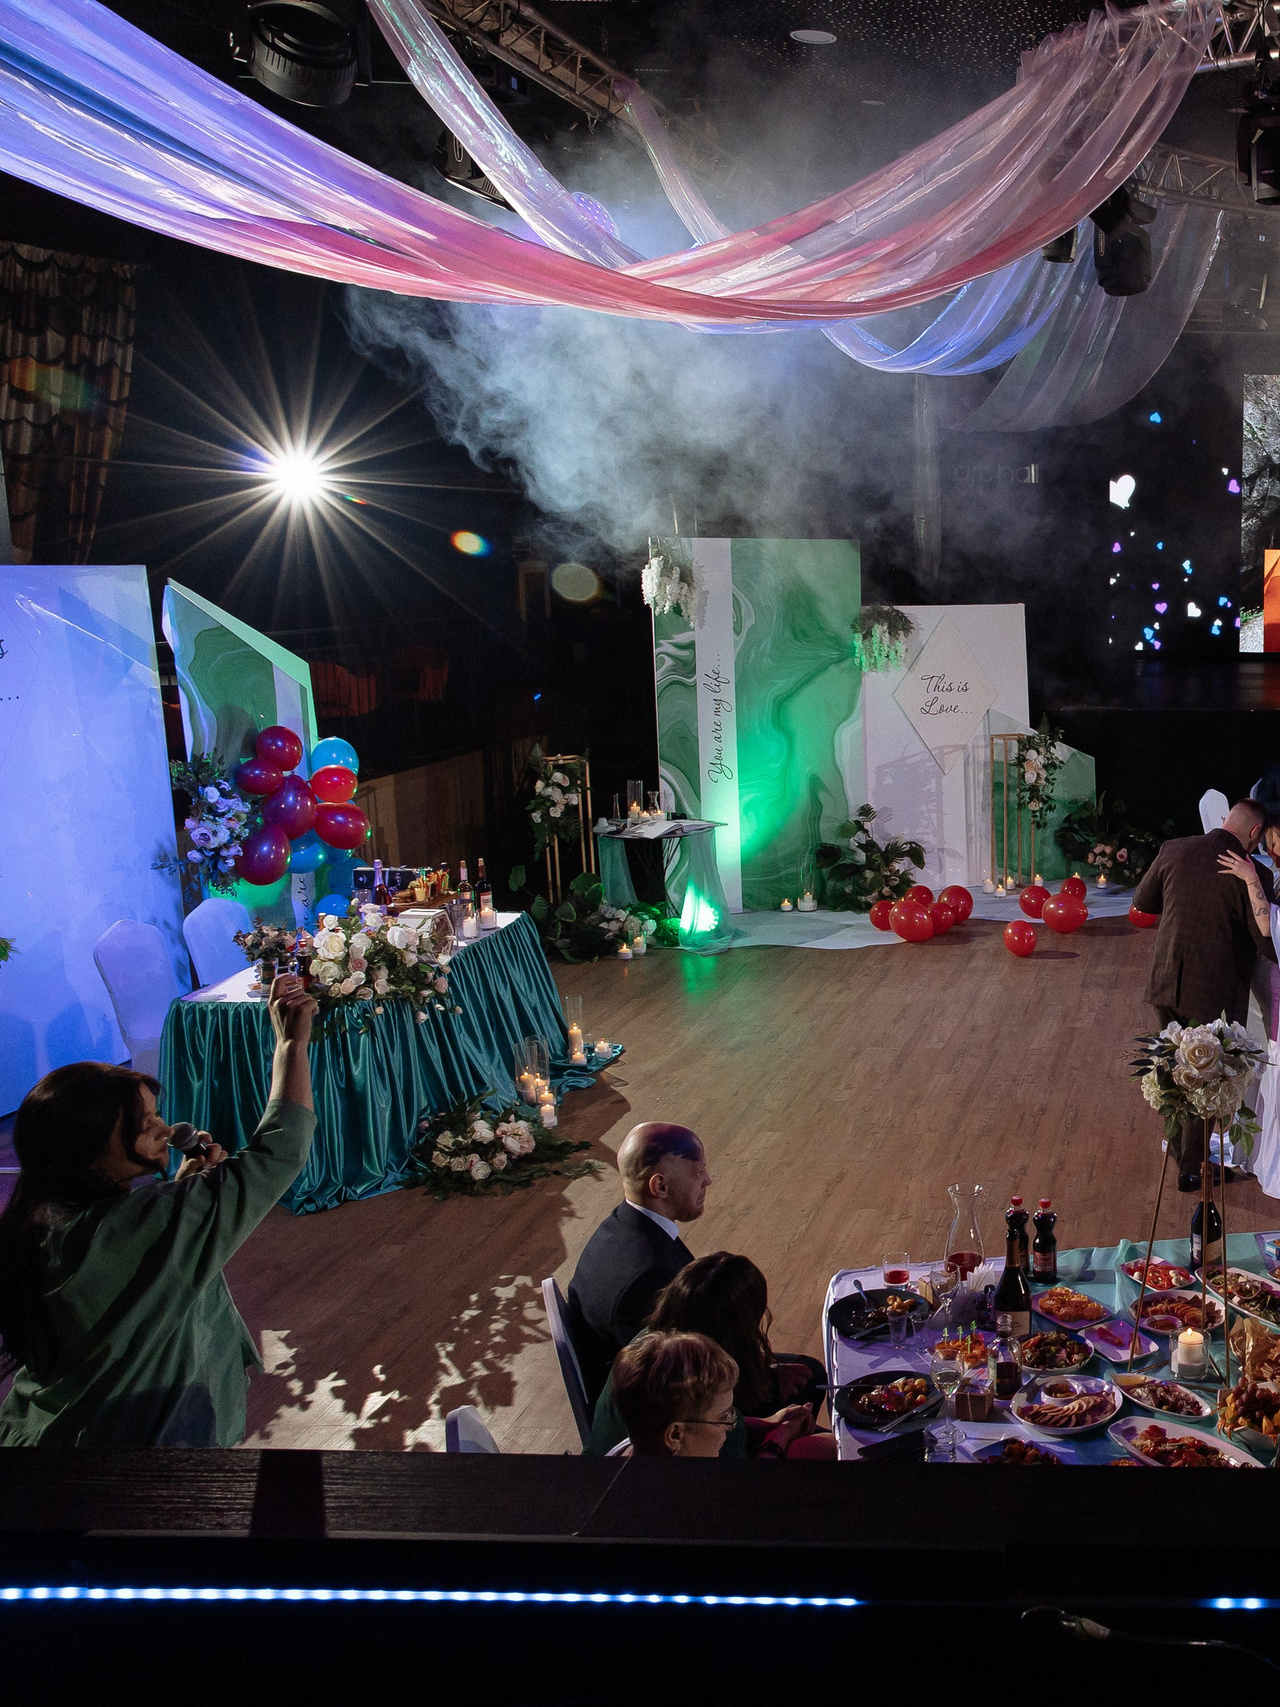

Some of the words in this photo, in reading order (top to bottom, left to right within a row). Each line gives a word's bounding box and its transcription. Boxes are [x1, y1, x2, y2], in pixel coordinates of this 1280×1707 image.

[920, 673, 955, 694] This
[956, 681, 970, 693] is
[713, 698, 733, 717] my
[920, 696, 973, 716] Love...
[711, 720, 723, 743] are
[707, 744, 733, 783] You
[297, 876, 308, 908] are
